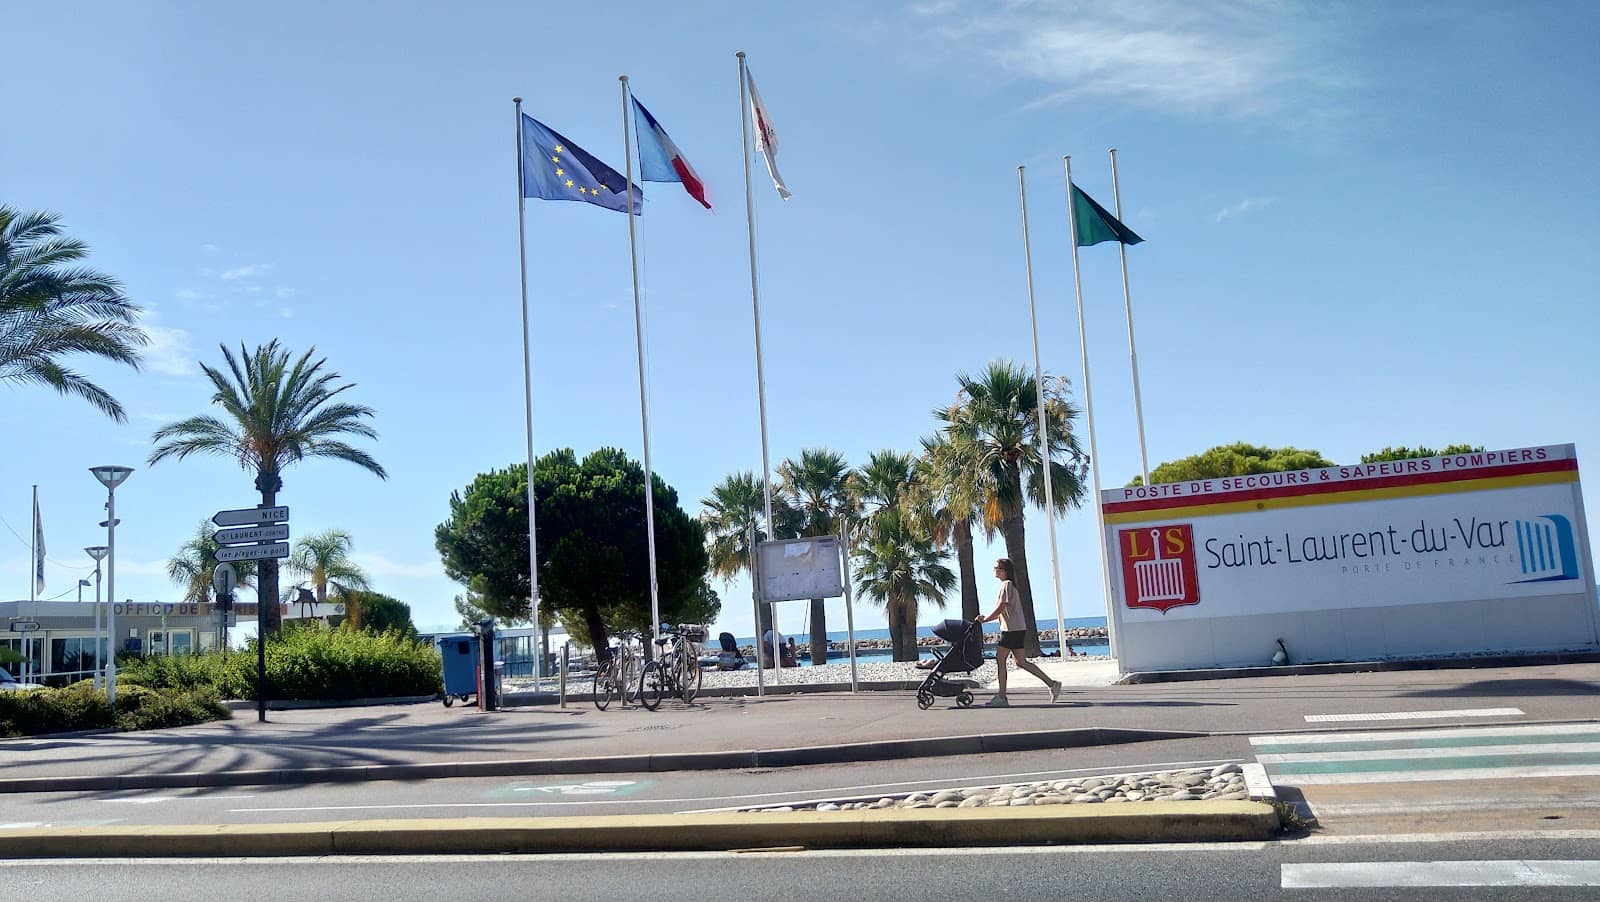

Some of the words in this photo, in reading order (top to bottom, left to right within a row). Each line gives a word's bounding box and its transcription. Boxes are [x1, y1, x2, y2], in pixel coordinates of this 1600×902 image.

[1124, 484, 1182, 500] POSTE
[1191, 481, 1213, 494] DE
[1222, 470, 1310, 490] SECOURS
[1319, 469, 1330, 481] &
[1340, 459, 1432, 479] SAPEURS
[1442, 448, 1547, 469] POMPIERS
[262, 510, 285, 520] NICE
[1205, 516, 1509, 569] Saint-Laurent-du-Var
[1342, 562, 1391, 575] PORTE
[1404, 560, 1423, 571] DE
[1434, 554, 1515, 570] FRANCE
[114, 603, 173, 616] OFFIC
[179, 603, 198, 616] DE
